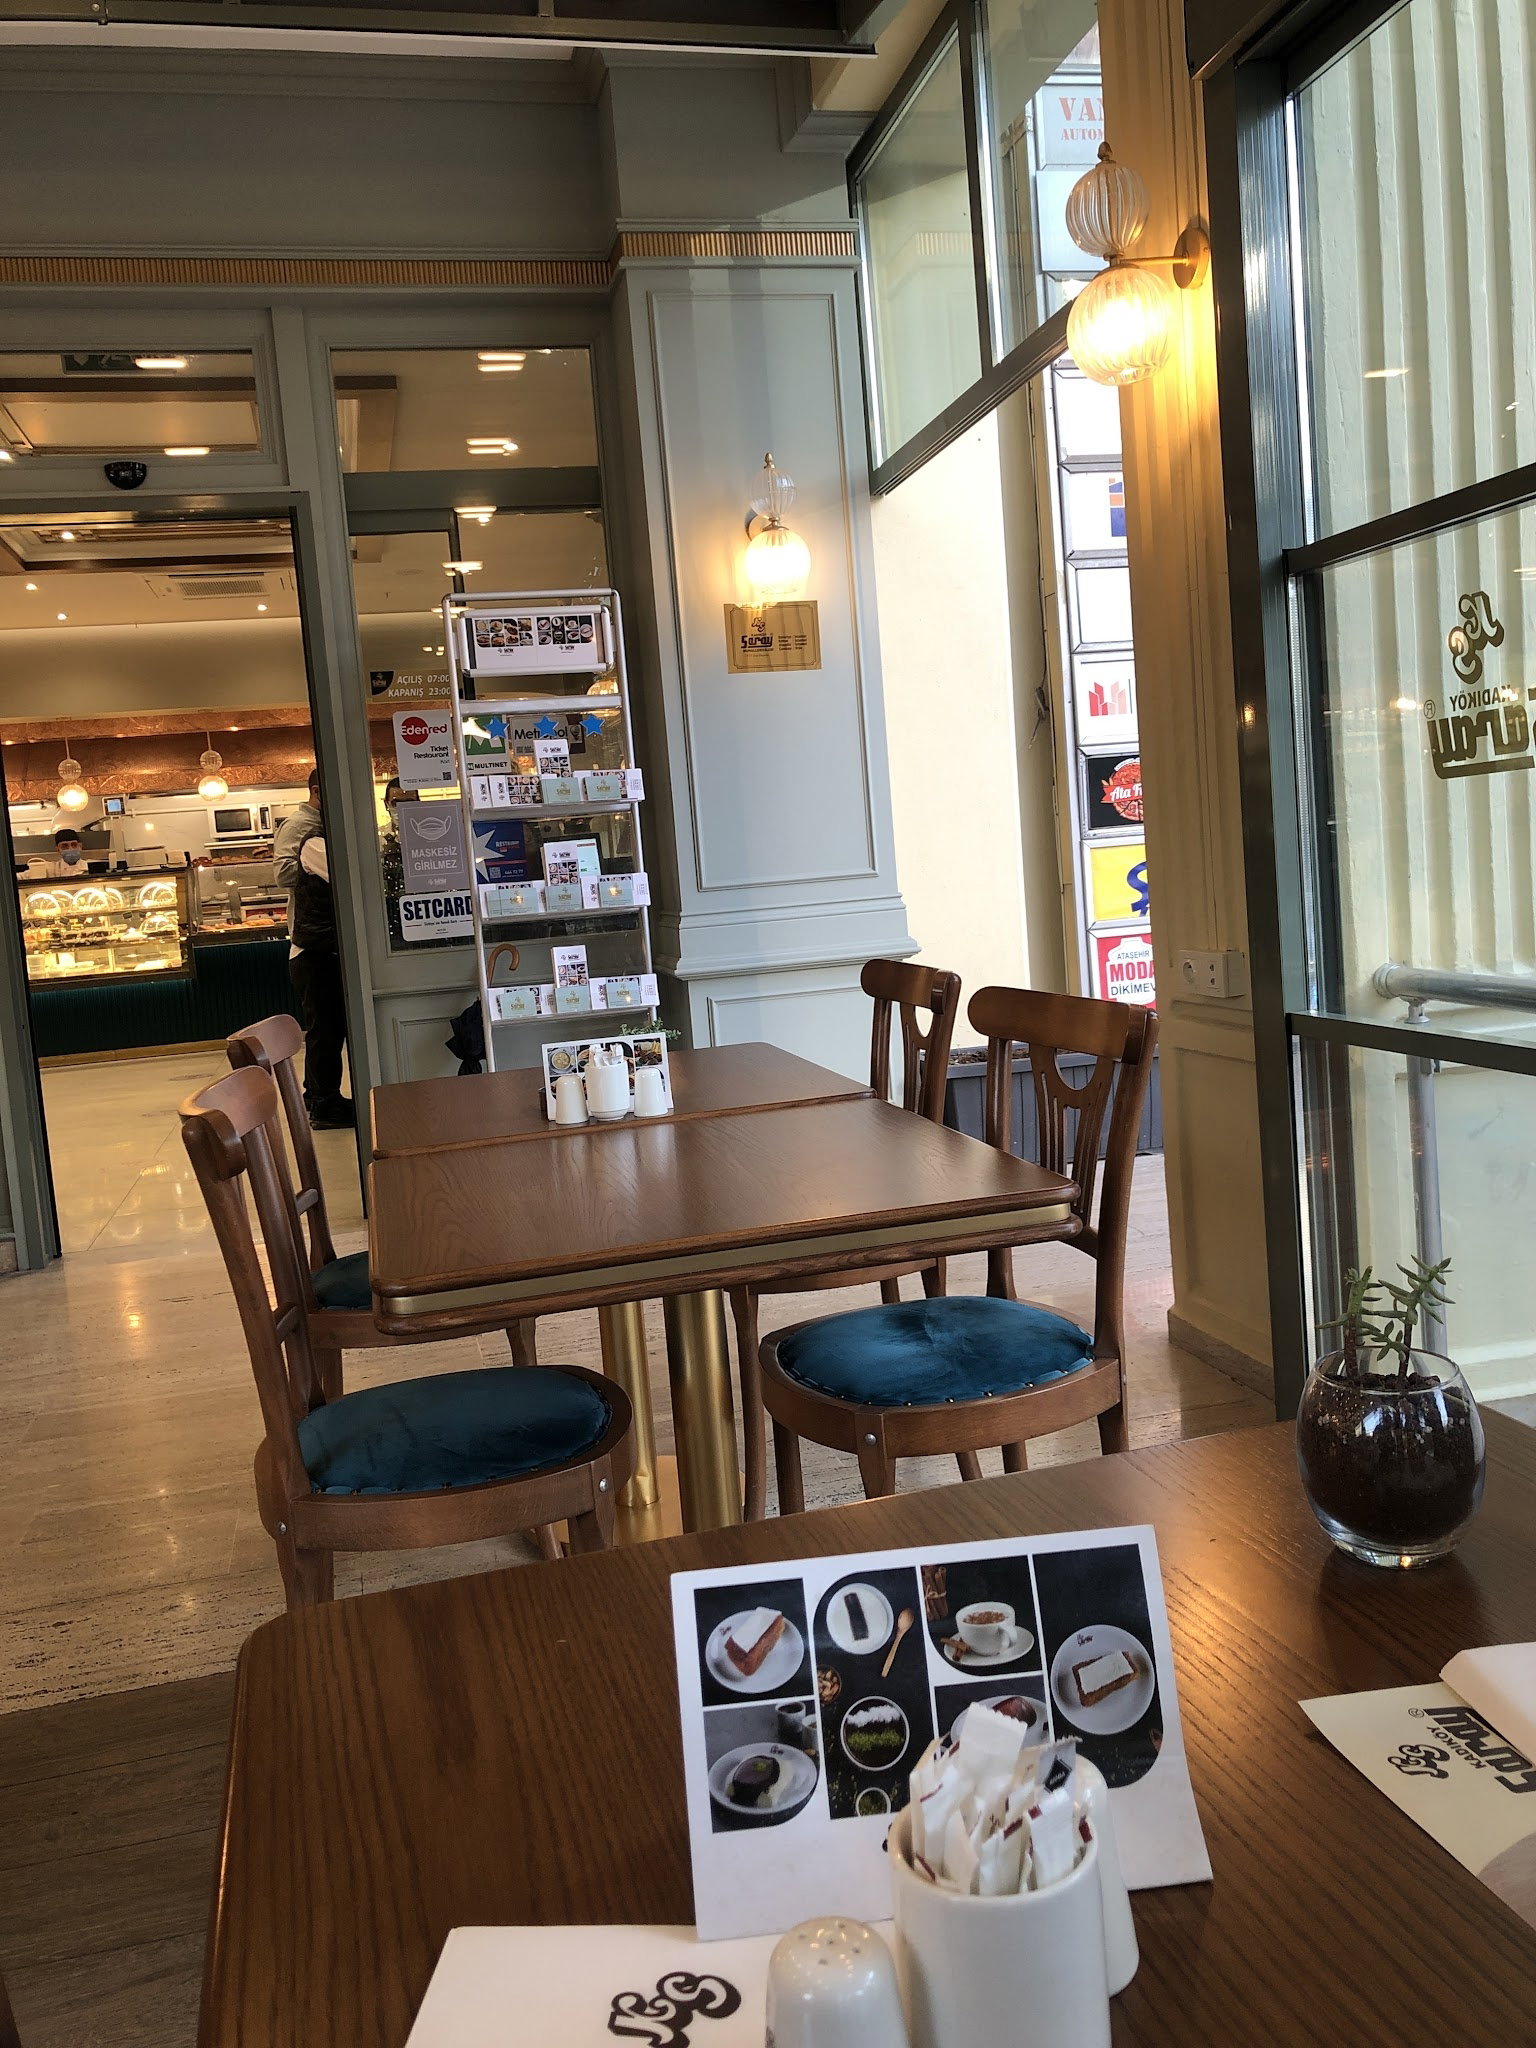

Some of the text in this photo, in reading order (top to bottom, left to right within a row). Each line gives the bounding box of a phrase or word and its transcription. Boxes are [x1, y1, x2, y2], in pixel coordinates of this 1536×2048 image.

[1059, 97, 1104, 121] VA
[397, 675, 422, 685] AÇILIŞ
[427, 674, 450, 683] 07:00
[388, 687, 450, 698] KAPANIŞ 23:00
[401, 723, 447, 735] Edenred
[413, 752, 449, 760] Restaurant
[1110, 786, 1131, 802] Ata
[411, 845, 458, 859] MASKESİZ
[414, 859, 458, 871] GİRİLMEZ
[402, 896, 473, 921] SETCARD
[1427, 1725, 1487, 1769] KADIKÖY
